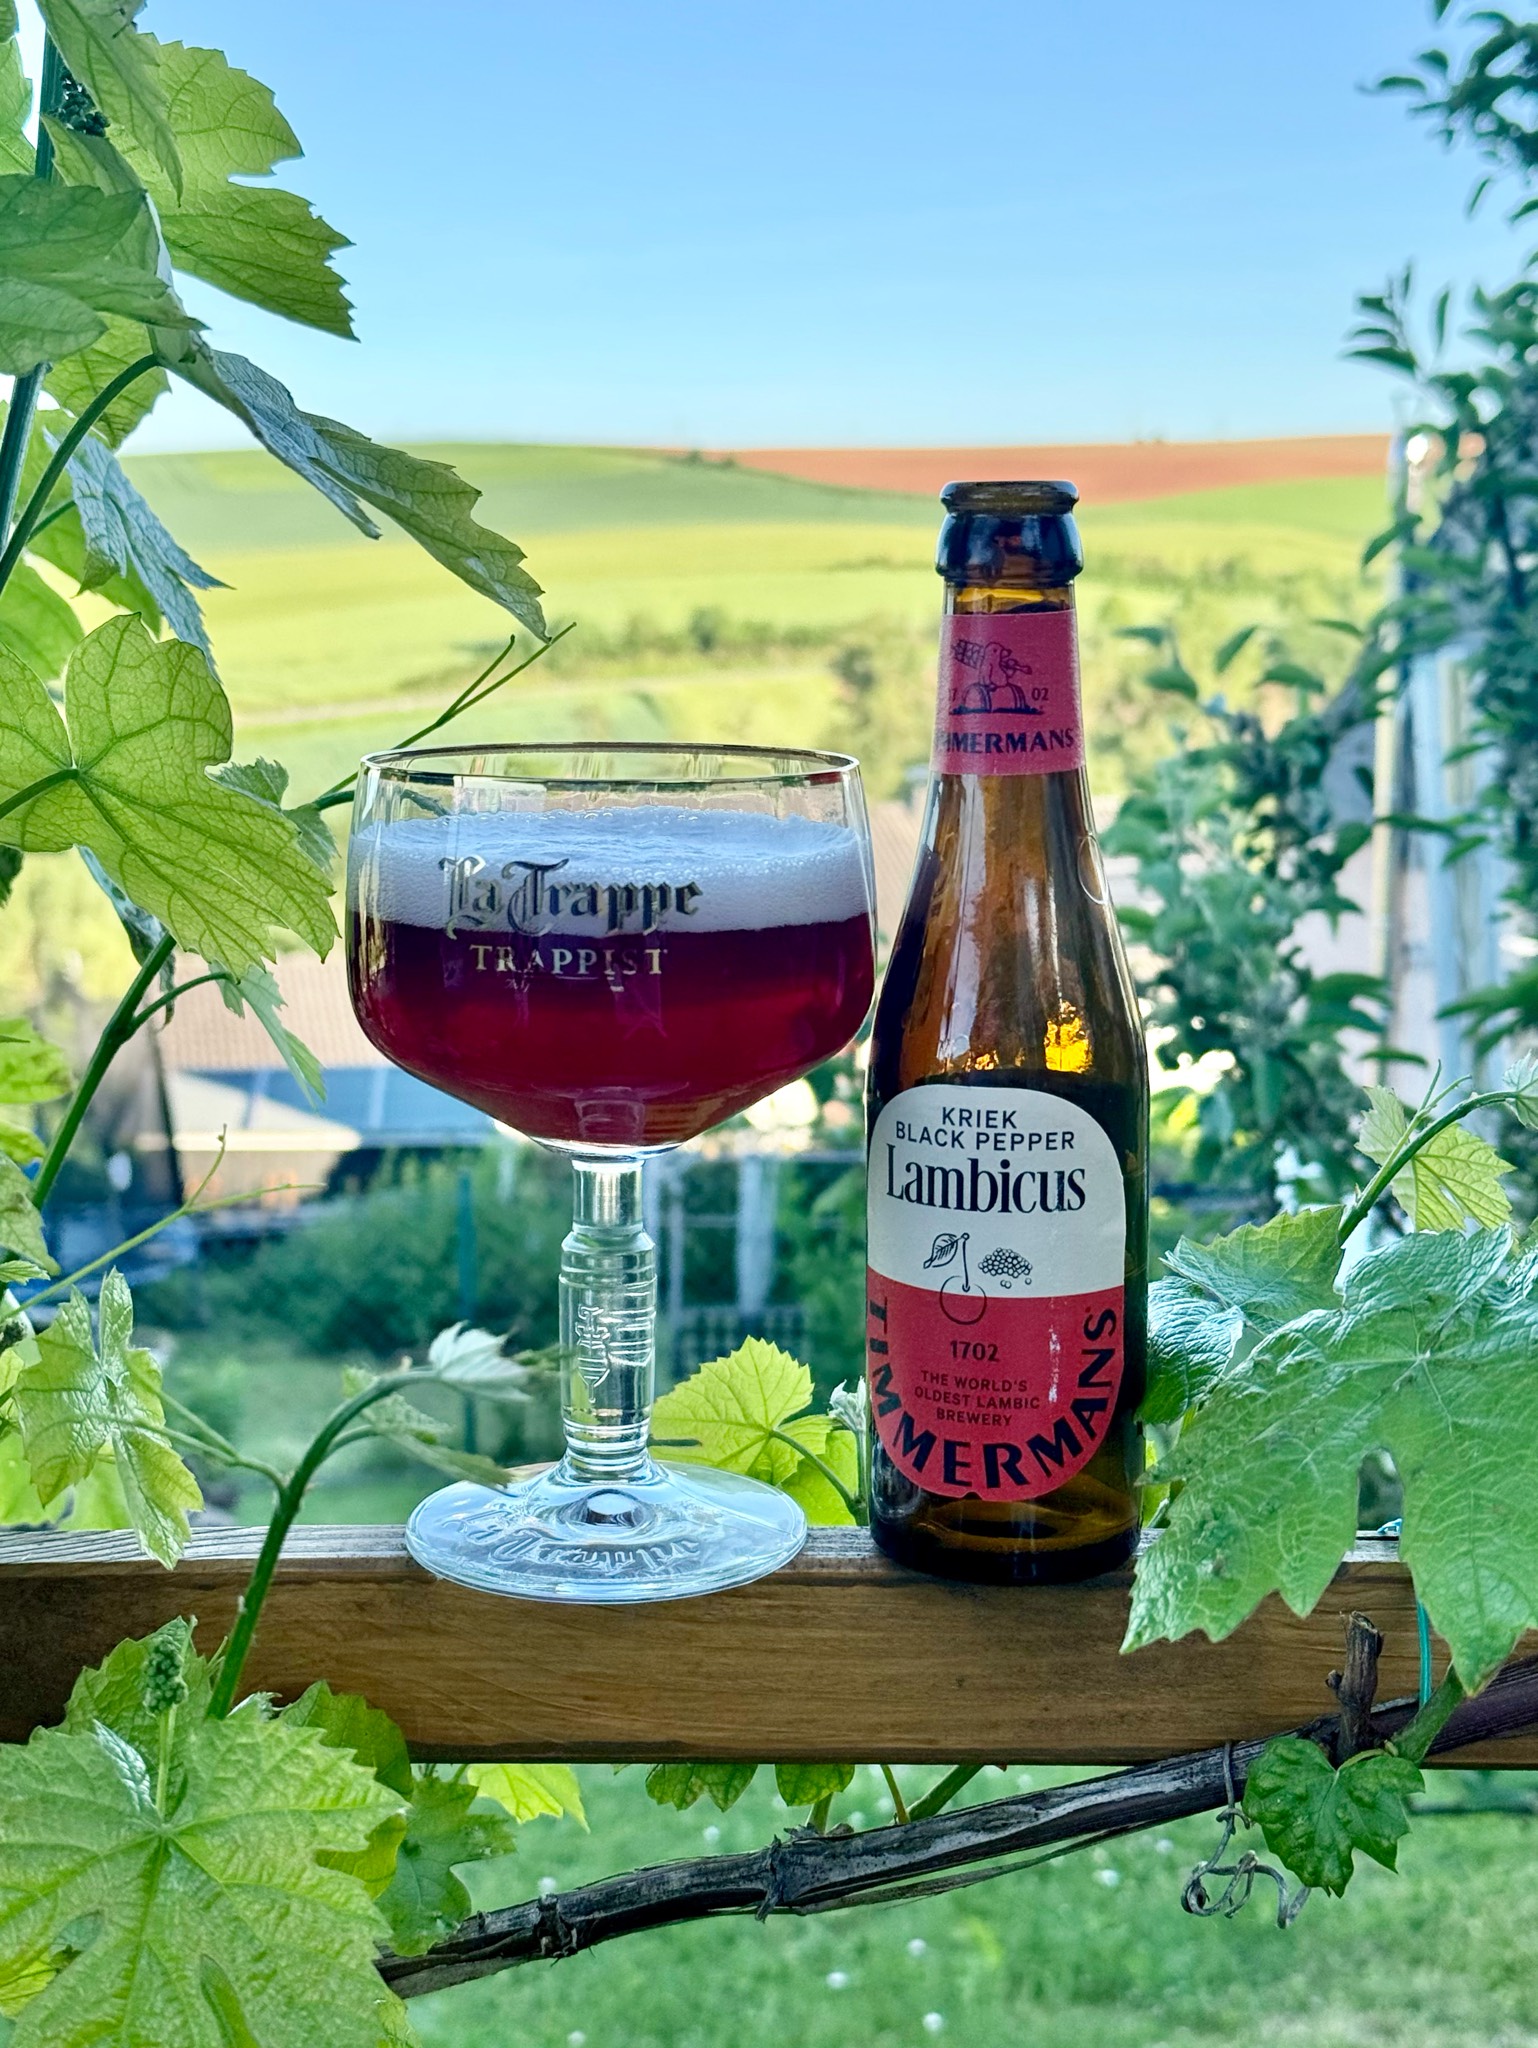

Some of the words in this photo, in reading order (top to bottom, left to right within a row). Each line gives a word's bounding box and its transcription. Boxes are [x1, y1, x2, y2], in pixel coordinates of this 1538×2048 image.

[438, 855, 502, 939] La
[502, 858, 703, 937] Trappe
[469, 944, 663, 975] TRAPPIST
[942, 1106, 1017, 1130] KRIEK
[896, 1120, 965, 1150] BLACK
[976, 1131, 1075, 1151] PEPPER
[886, 1143, 1086, 1213] Lambicus
[950, 1340, 1000, 1362] 1702
[869, 1297, 1117, 1489] TIMMERMANS
[921, 1370, 949, 1386] THE
[955, 1376, 1028, 1393] WORLD'S
[914, 1386, 971, 1407] OLDEST
[976, 1395, 1040, 1410] LAMBIC
[936, 1407, 1013, 1426] BREWERY
